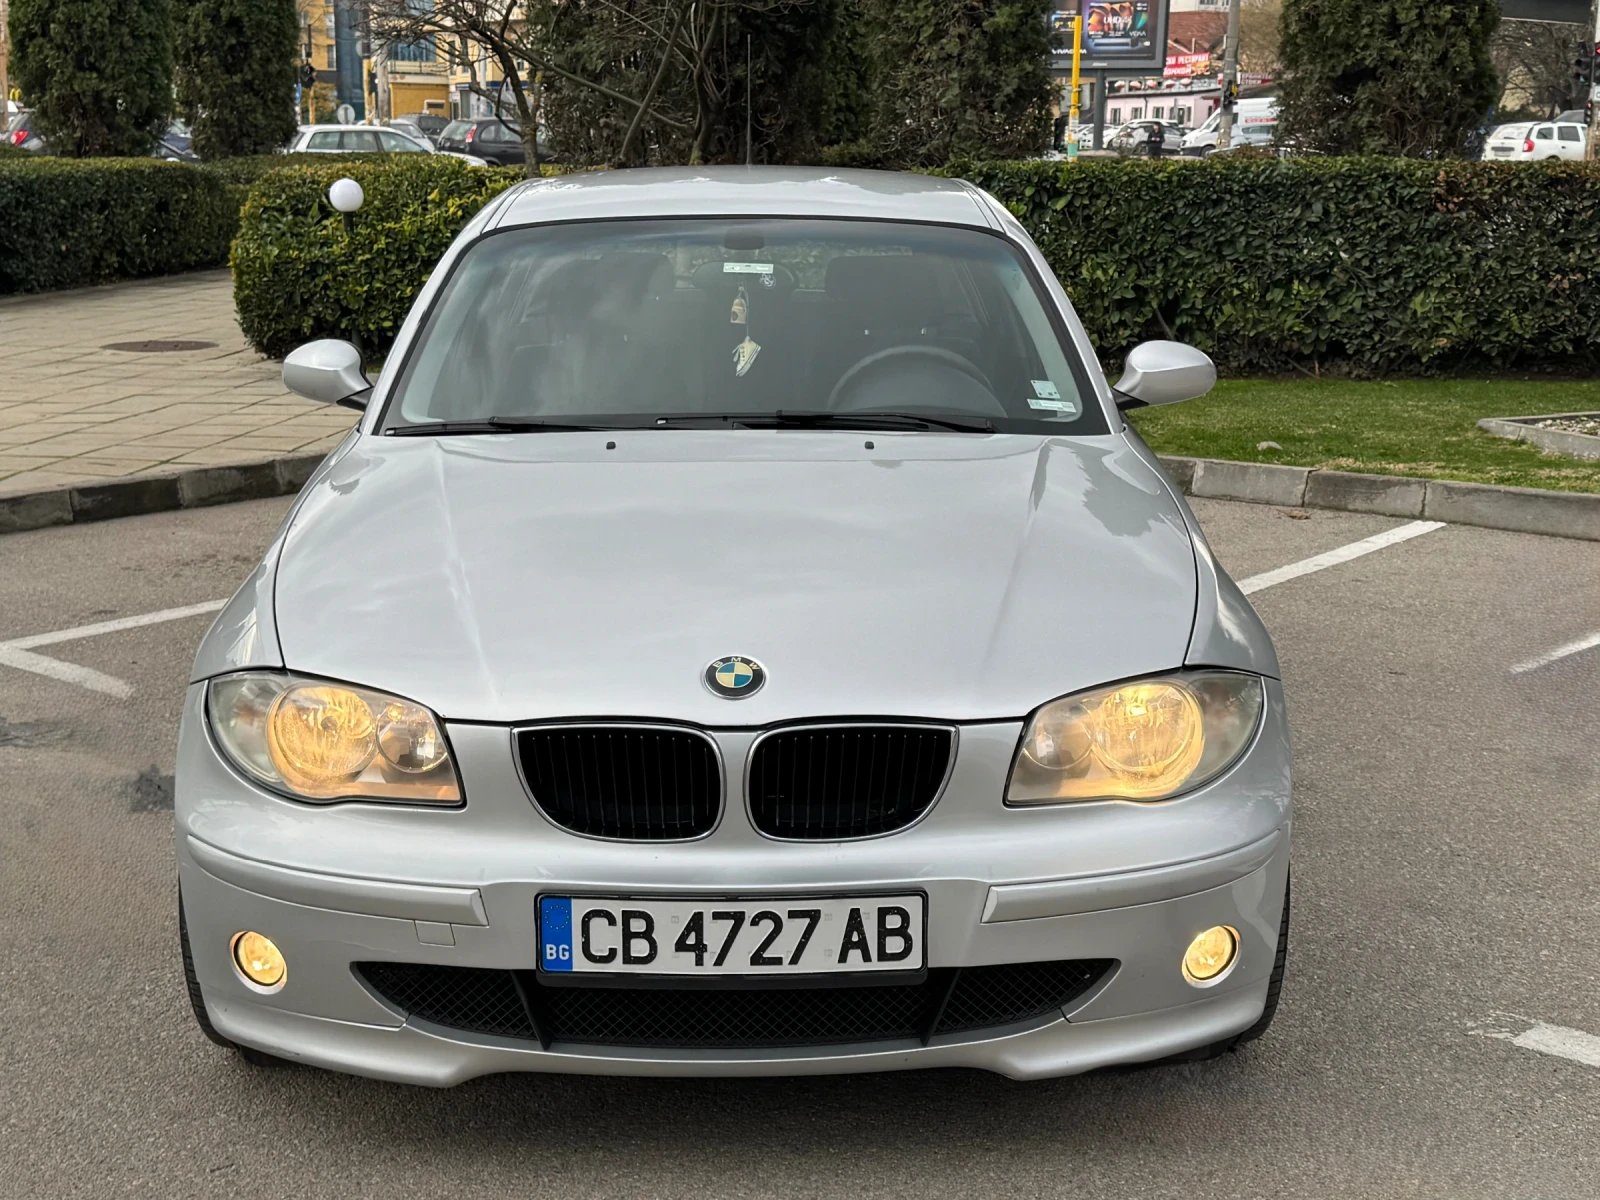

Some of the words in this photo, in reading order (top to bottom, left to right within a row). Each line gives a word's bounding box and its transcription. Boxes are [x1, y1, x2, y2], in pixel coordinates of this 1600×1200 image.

[712, 657, 760, 670] BMW
[581, 908, 658, 965] CB
[674, 909, 822, 967] 4727
[837, 906, 913, 963] AB
[545, 943, 570, 960] BG
